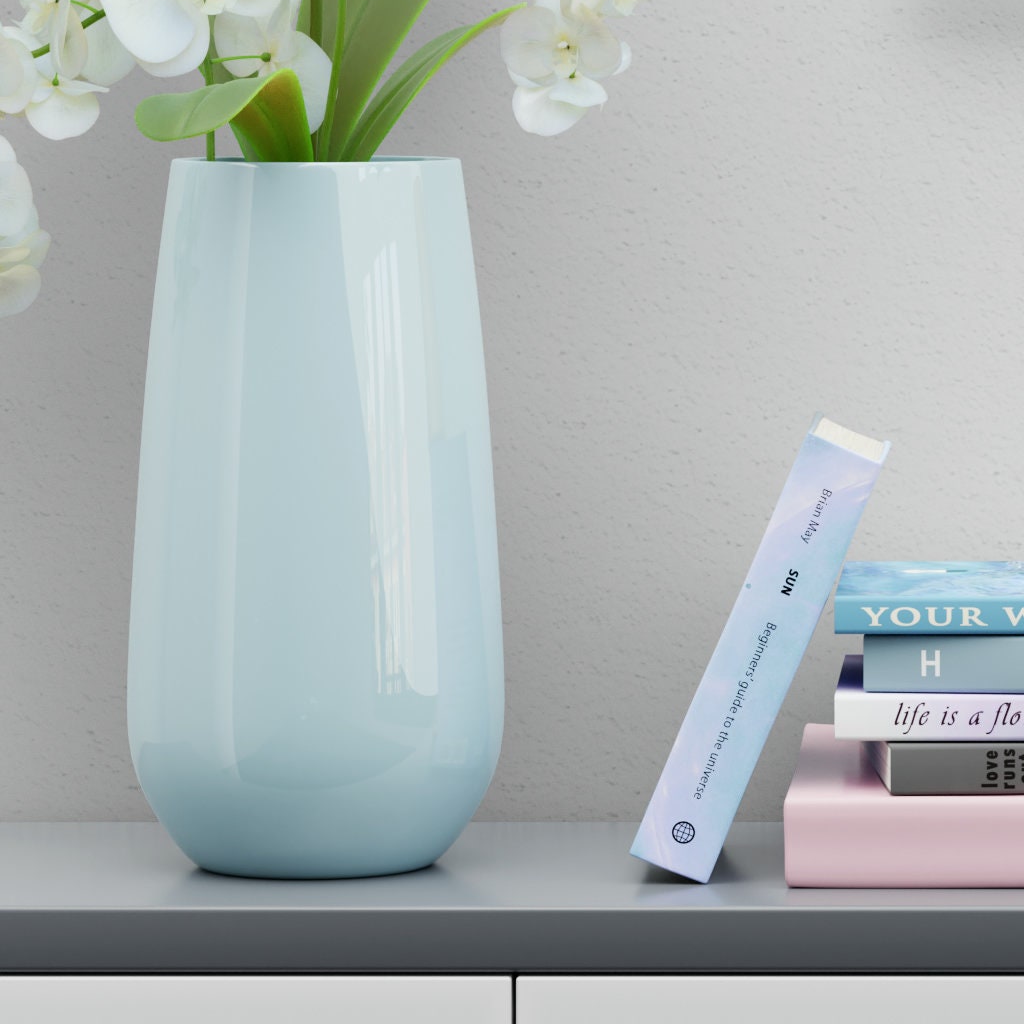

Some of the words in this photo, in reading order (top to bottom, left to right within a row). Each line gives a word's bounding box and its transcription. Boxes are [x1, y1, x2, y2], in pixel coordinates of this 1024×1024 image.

[812, 488, 833, 518] Brian
[800, 519, 820, 545] May
[780, 568, 799, 597] SUN
[860, 606, 989, 627] YOUR
[729, 680, 750, 715] guide
[723, 716, 735, 728] to
[893, 702, 931, 735] life
[940, 706, 958, 726] is
[968, 709, 984, 726] a
[713, 732, 729, 750] the
[693, 753, 719, 800] universe
[980, 750, 999, 788] love
[1003, 748, 1016, 789] runs
